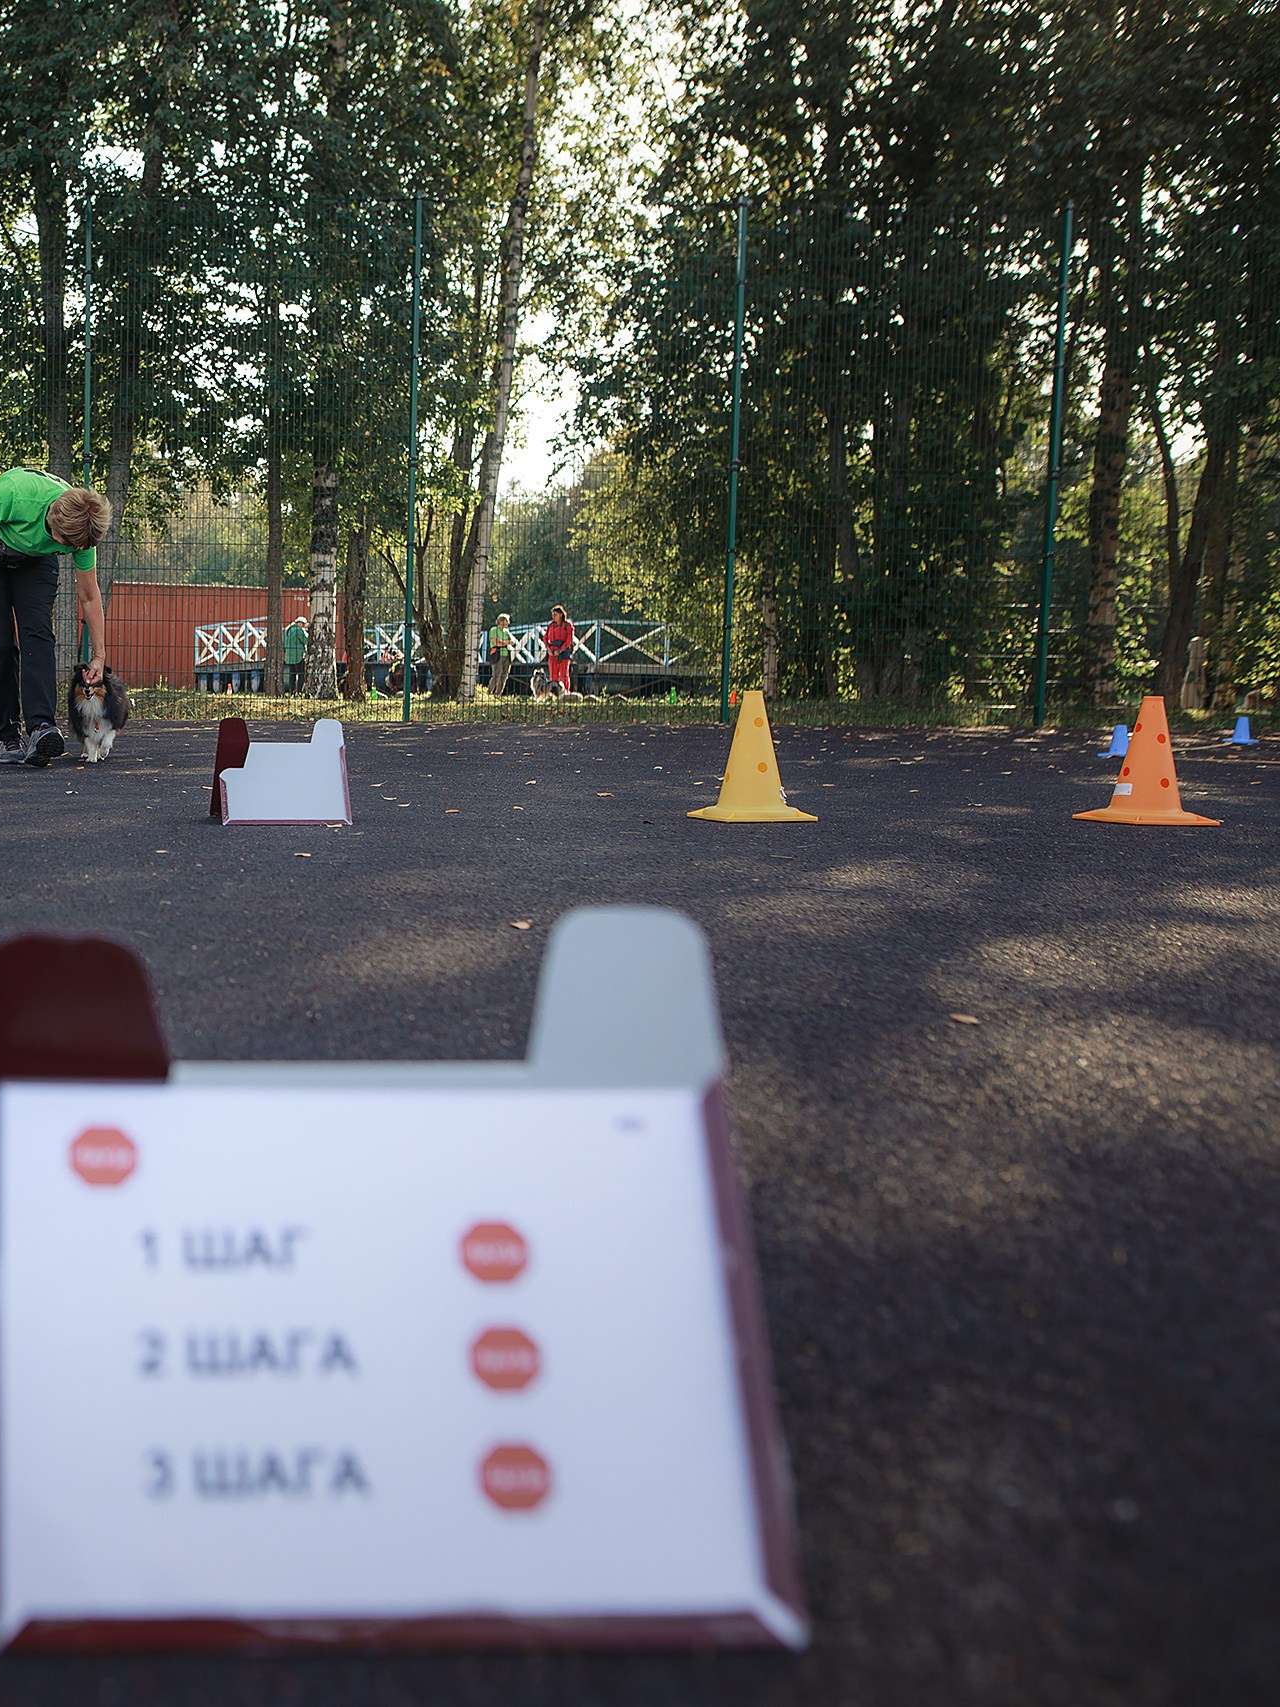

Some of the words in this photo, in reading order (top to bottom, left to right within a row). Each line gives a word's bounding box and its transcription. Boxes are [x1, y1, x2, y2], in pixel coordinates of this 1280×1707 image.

[139, 1226, 160, 1271] 1
[181, 1225, 308, 1273] ШАГ
[138, 1327, 167, 1377] 2
[185, 1326, 361, 1378] ШАГА
[144, 1446, 174, 1499] 3
[192, 1444, 372, 1500] ШАГА
